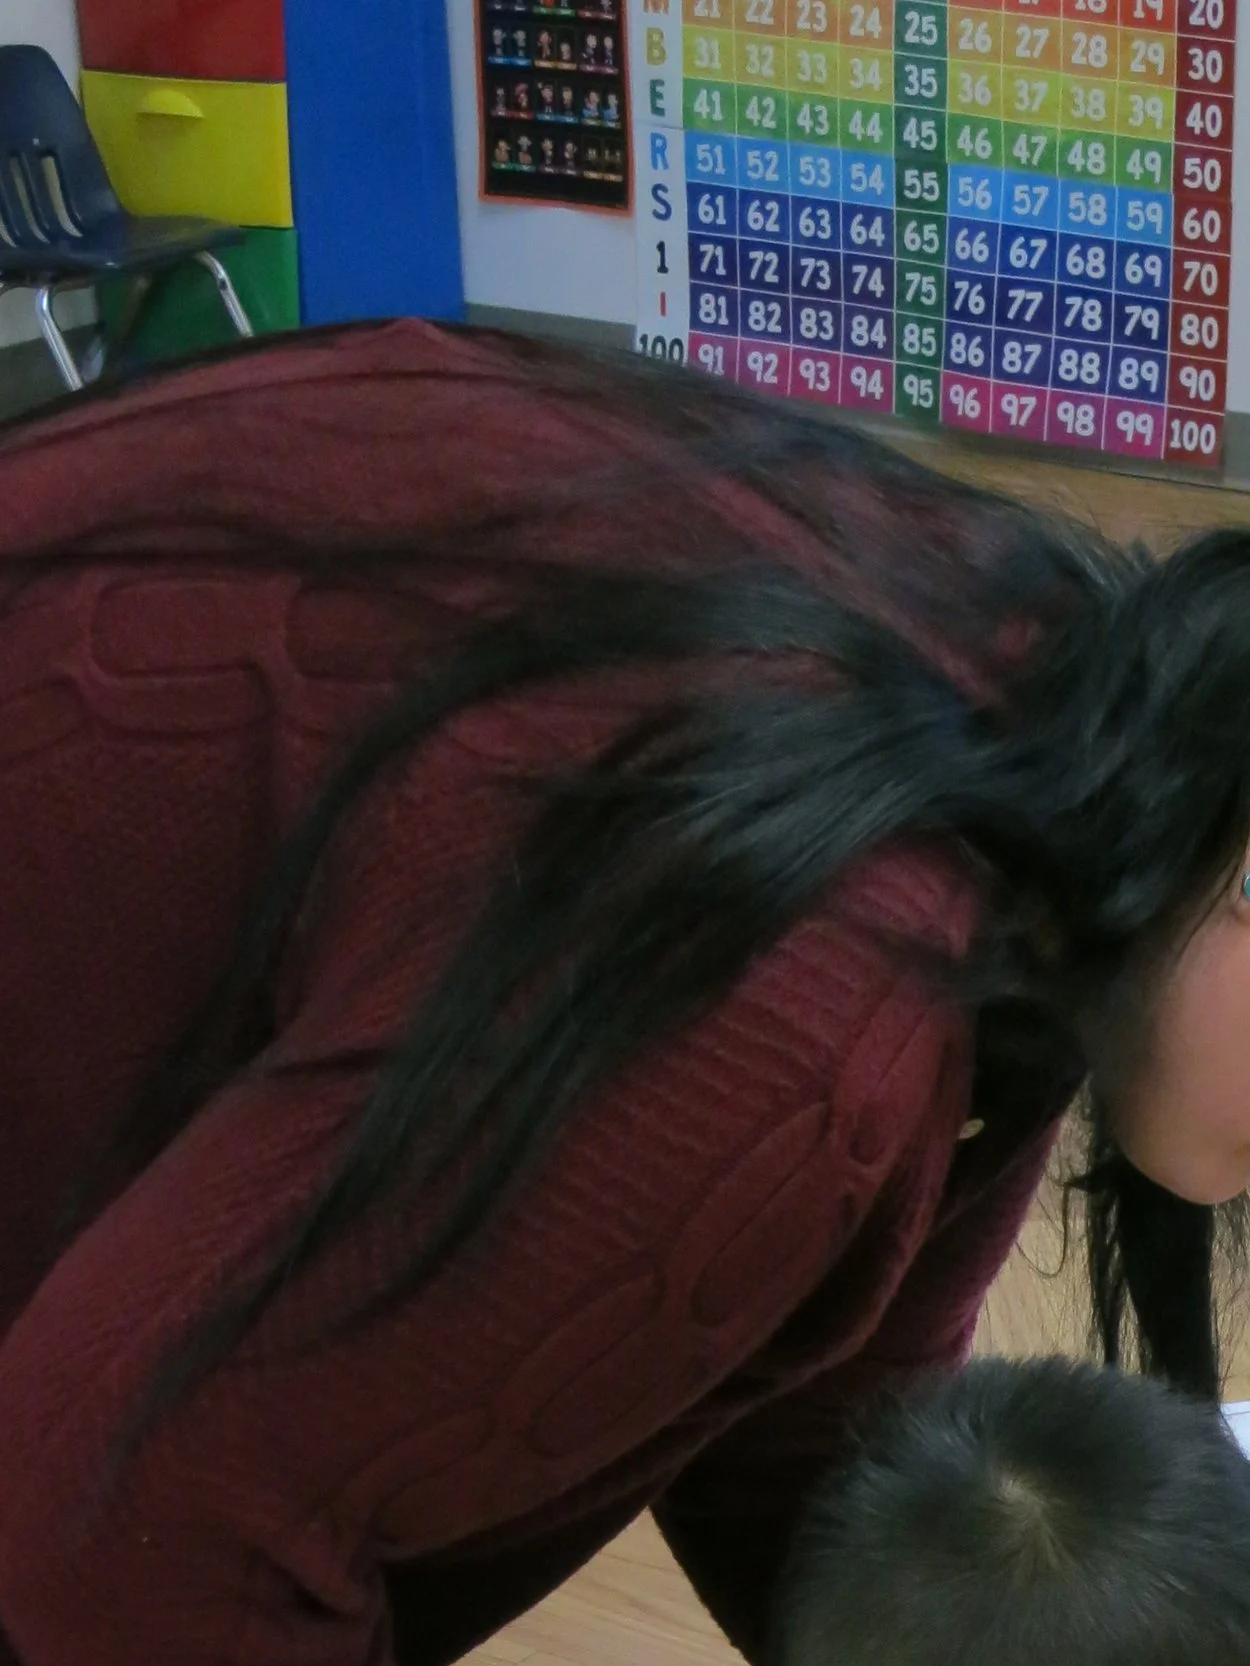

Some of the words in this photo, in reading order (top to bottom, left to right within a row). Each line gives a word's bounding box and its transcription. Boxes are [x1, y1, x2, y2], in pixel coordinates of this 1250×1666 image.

[745, 0, 774, 25] 22
[796, 1, 828, 32] 23
[849, 5, 882, 38] 24
[904, 11, 937, 46] 25
[959, 18, 992, 53] 26
[1016, 25, 1049, 59] 27
[1072, 32, 1108, 68] 28
[1129, 40, 1165, 75] 29
[1188, 48, 1223, 83] 30
[1189, 0, 1225, 29] 20
[694, 37, 721, 69] 31
[746, 45, 774, 77] 32
[796, 52, 827, 84] 33
[849, 58, 882, 91] 34
[904, 65, 937, 97] 35
[958, 73, 992, 105] 36
[1014, 79, 1048, 111] 37
[1070, 87, 1106, 121] 38
[1128, 94, 1164, 129] 39
[1186, 104, 1222, 138] 40
[694, 89, 723, 120] 41
[746, 96, 776, 129] 42
[797, 103, 829, 135] 43
[849, 110, 883, 143] 44
[903, 117, 938, 151] 45
[957, 125, 992, 159] 46
[1012, 134, 1047, 167] 47
[1067, 140, 1106, 175] 48
[1126, 149, 1162, 184] 49
[1183, 157, 1221, 192] 50
[696, 144, 725, 175] 51
[747, 151, 779, 181] 52
[799, 157, 831, 188] 53
[851, 163, 884, 195] 54
[904, 169, 939, 201] 55
[957, 177, 992, 210] 56
[1012, 185, 1048, 217] 57
[1068, 192, 1107, 226] 58
[1127, 201, 1163, 234] 59
[1183, 207, 1221, 242] 60
[698, 193, 726, 225] 61
[747, 200, 780, 232] 62
[800, 207, 832, 239] 63
[850, 213, 885, 247] 64
[903, 220, 939, 254] 65
[955, 228, 989, 263] 66
[1009, 236, 1047, 269] 67
[1066, 244, 1105, 279] 68
[1125, 252, 1162, 287] 69
[1183, 261, 1218, 296] 70
[699, 244, 727, 276] 71
[749, 251, 779, 284] 72
[800, 258, 831, 290] 73
[852, 265, 885, 298] 74
[905, 272, 936, 305] 75
[954, 281, 985, 315] 76
[1007, 289, 1043, 322] 77
[1064, 297, 1102, 331] 78
[1124, 305, 1160, 340] 79
[1179, 313, 1218, 349] 80
[699, 293, 729, 325] 81
[749, 301, 782, 333] 82
[800, 308, 833, 341] 83
[851, 315, 886, 349] 84
[903, 323, 936, 356] 85
[950, 333, 984, 367] 86
[1002, 341, 1041, 374] 87
[1058, 349, 1100, 384] 88
[1118, 357, 1159, 392] 89
[1179, 366, 1215, 401] 90
[698, 343, 724, 375] 91
[747, 351, 778, 383] 92
[800, 358, 830, 391] 93
[851, 366, 883, 400] 94
[903, 374, 933, 408] 95
[950, 384, 980, 418] 96
[1000, 393, 1037, 426] 97
[1056, 401, 1095, 436] 98
[1116, 410, 1153, 446] 99
[1169, 419, 1215, 454] 100
